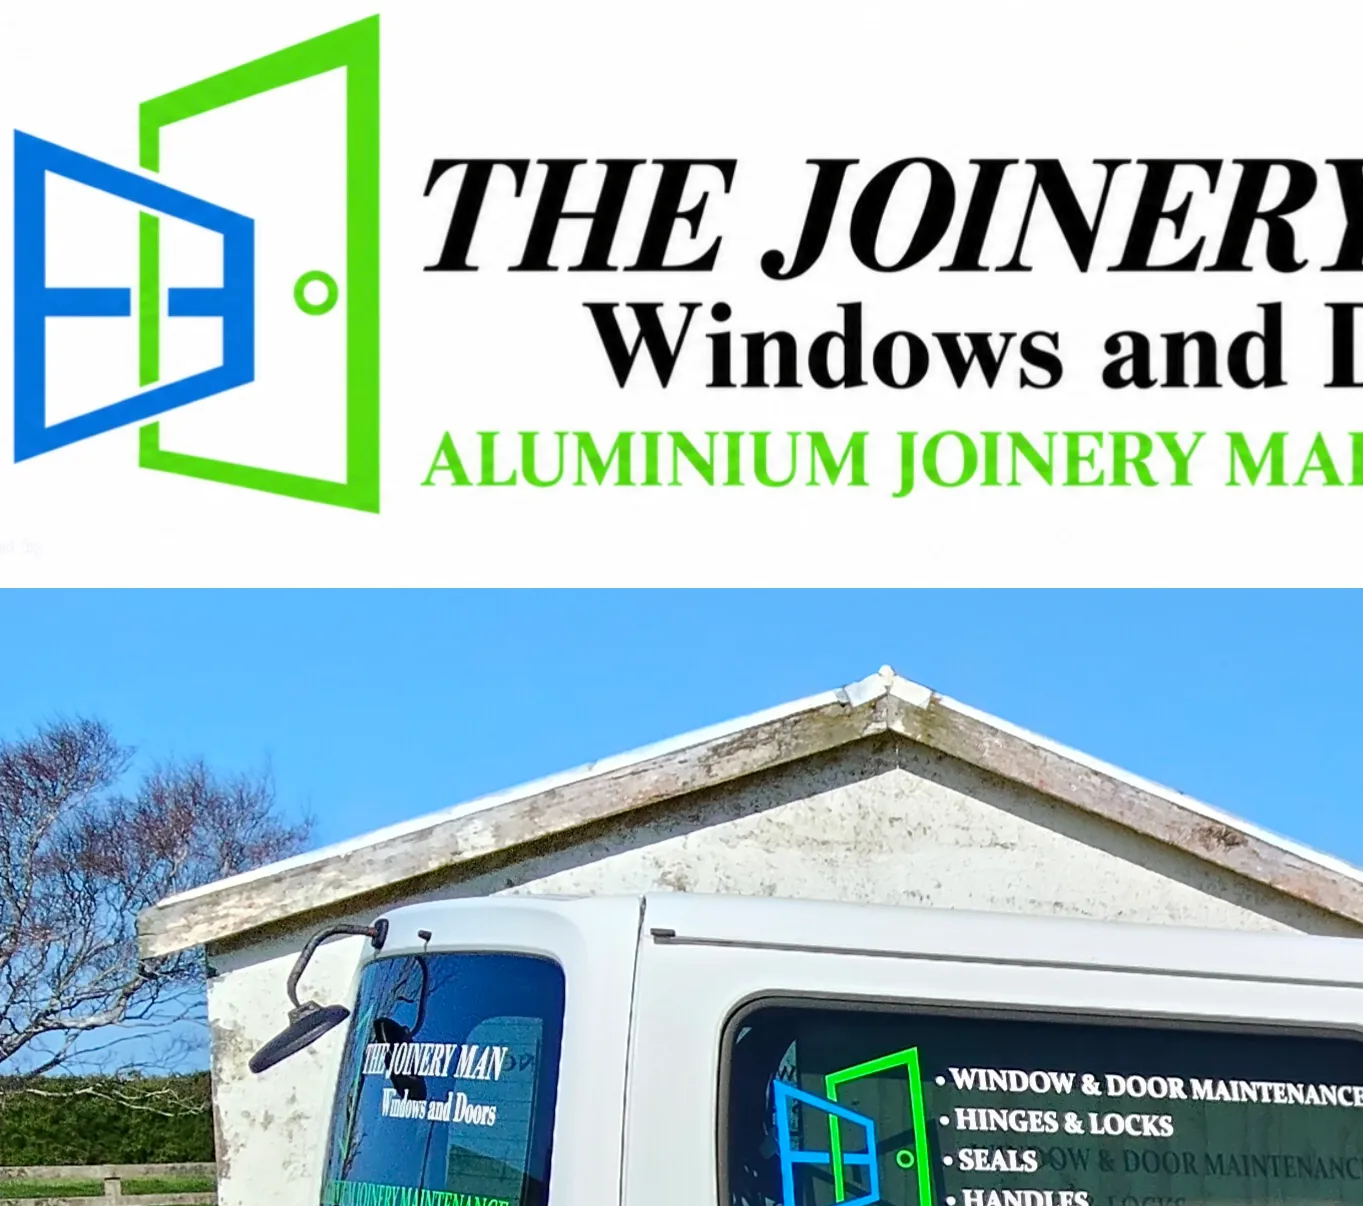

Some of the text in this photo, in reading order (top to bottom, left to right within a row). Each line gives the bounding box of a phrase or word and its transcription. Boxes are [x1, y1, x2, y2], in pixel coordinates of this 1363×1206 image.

[362, 1043, 390, 1074] THE
[385, 1043, 457, 1079] JOINERY
[454, 1044, 508, 1081] MAN
[949, 1067, 1076, 1094] WINDOW
[1081, 1073, 1103, 1096] &
[1104, 1074, 1187, 1099] DOOR
[381, 1088, 496, 1126] Windows and Doors
[954, 1107, 1174, 1137] HINGES & LOCKS
[958, 1148, 1038, 1172] SEALS
[1124, 1150, 1199, 1175] DOOR
